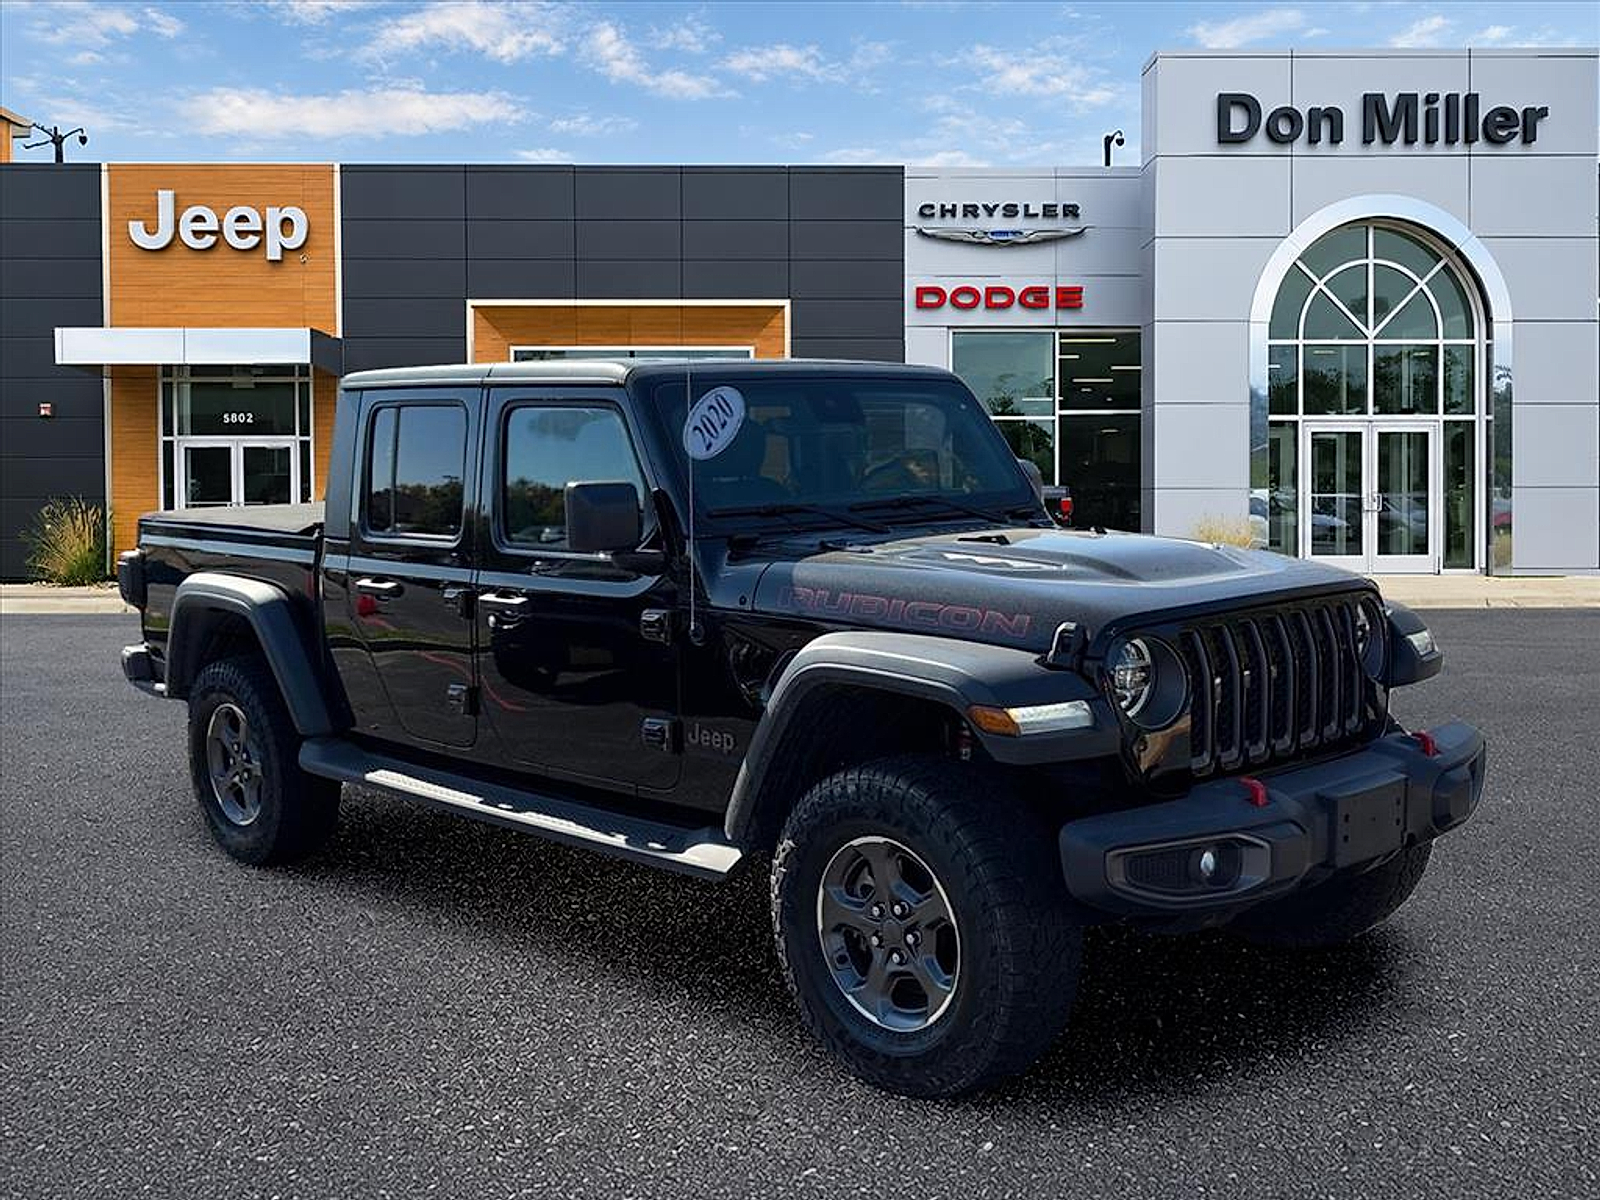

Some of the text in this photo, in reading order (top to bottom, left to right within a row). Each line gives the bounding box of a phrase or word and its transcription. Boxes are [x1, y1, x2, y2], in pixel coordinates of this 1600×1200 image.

[1216, 93, 1549, 145] Don Miller
[127, 189, 309, 261] Jeep
[918, 202, 1082, 219] CHRYSLER
[915, 285, 1084, 310] DODGE
[222, 412, 254, 425] 5802
[691, 393, 735, 452] 2020
[777, 586, 1031, 638] RUBICON
[687, 721, 735, 754] Jeep
